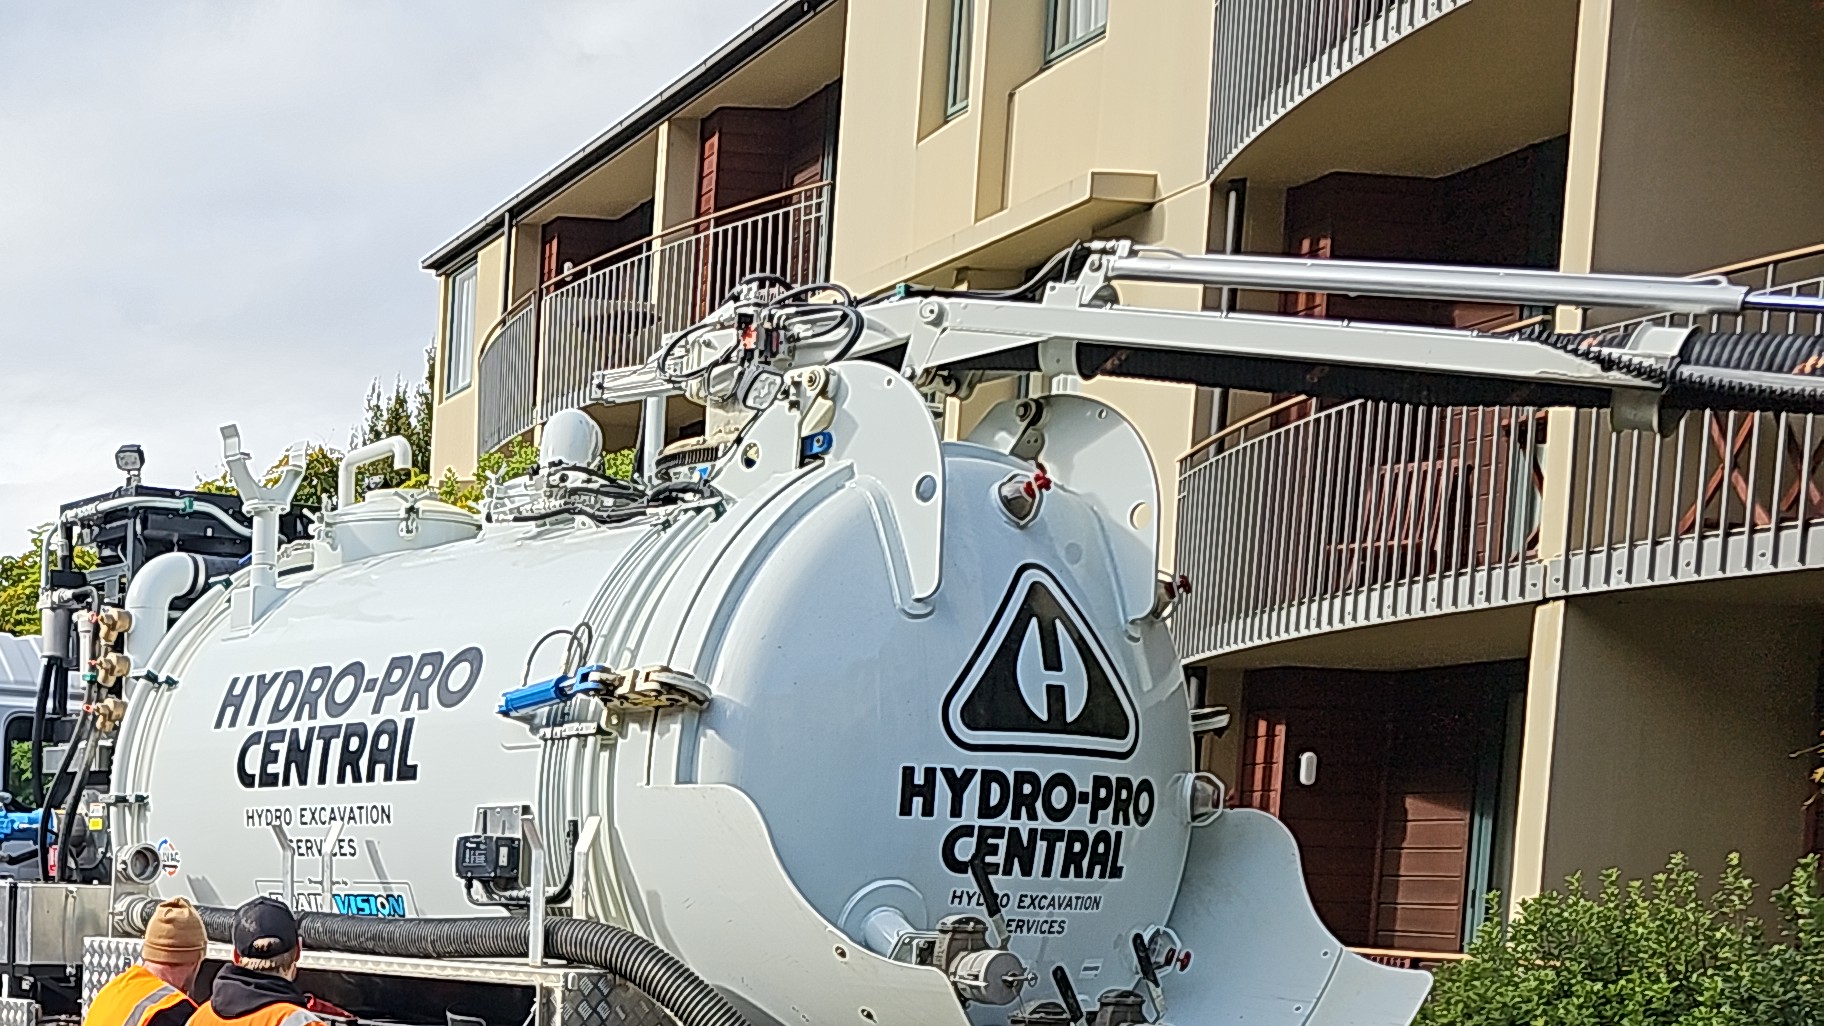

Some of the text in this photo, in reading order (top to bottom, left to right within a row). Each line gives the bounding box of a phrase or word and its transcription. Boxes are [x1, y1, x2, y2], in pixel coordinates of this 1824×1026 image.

[214, 646, 484, 730] HYDRO-PRO
[236, 717, 419, 789] CENTRAL
[246, 804, 392, 827] HYDRO EXCAVATION
[899, 766, 1155, 827] HYDRO-PRO
[942, 825, 1125, 879] CENTRAL
[333, 894, 405, 917] VISION
[1017, 893, 1102, 911] EXCAVATION
[1006, 918, 1066, 935] ERVICES
